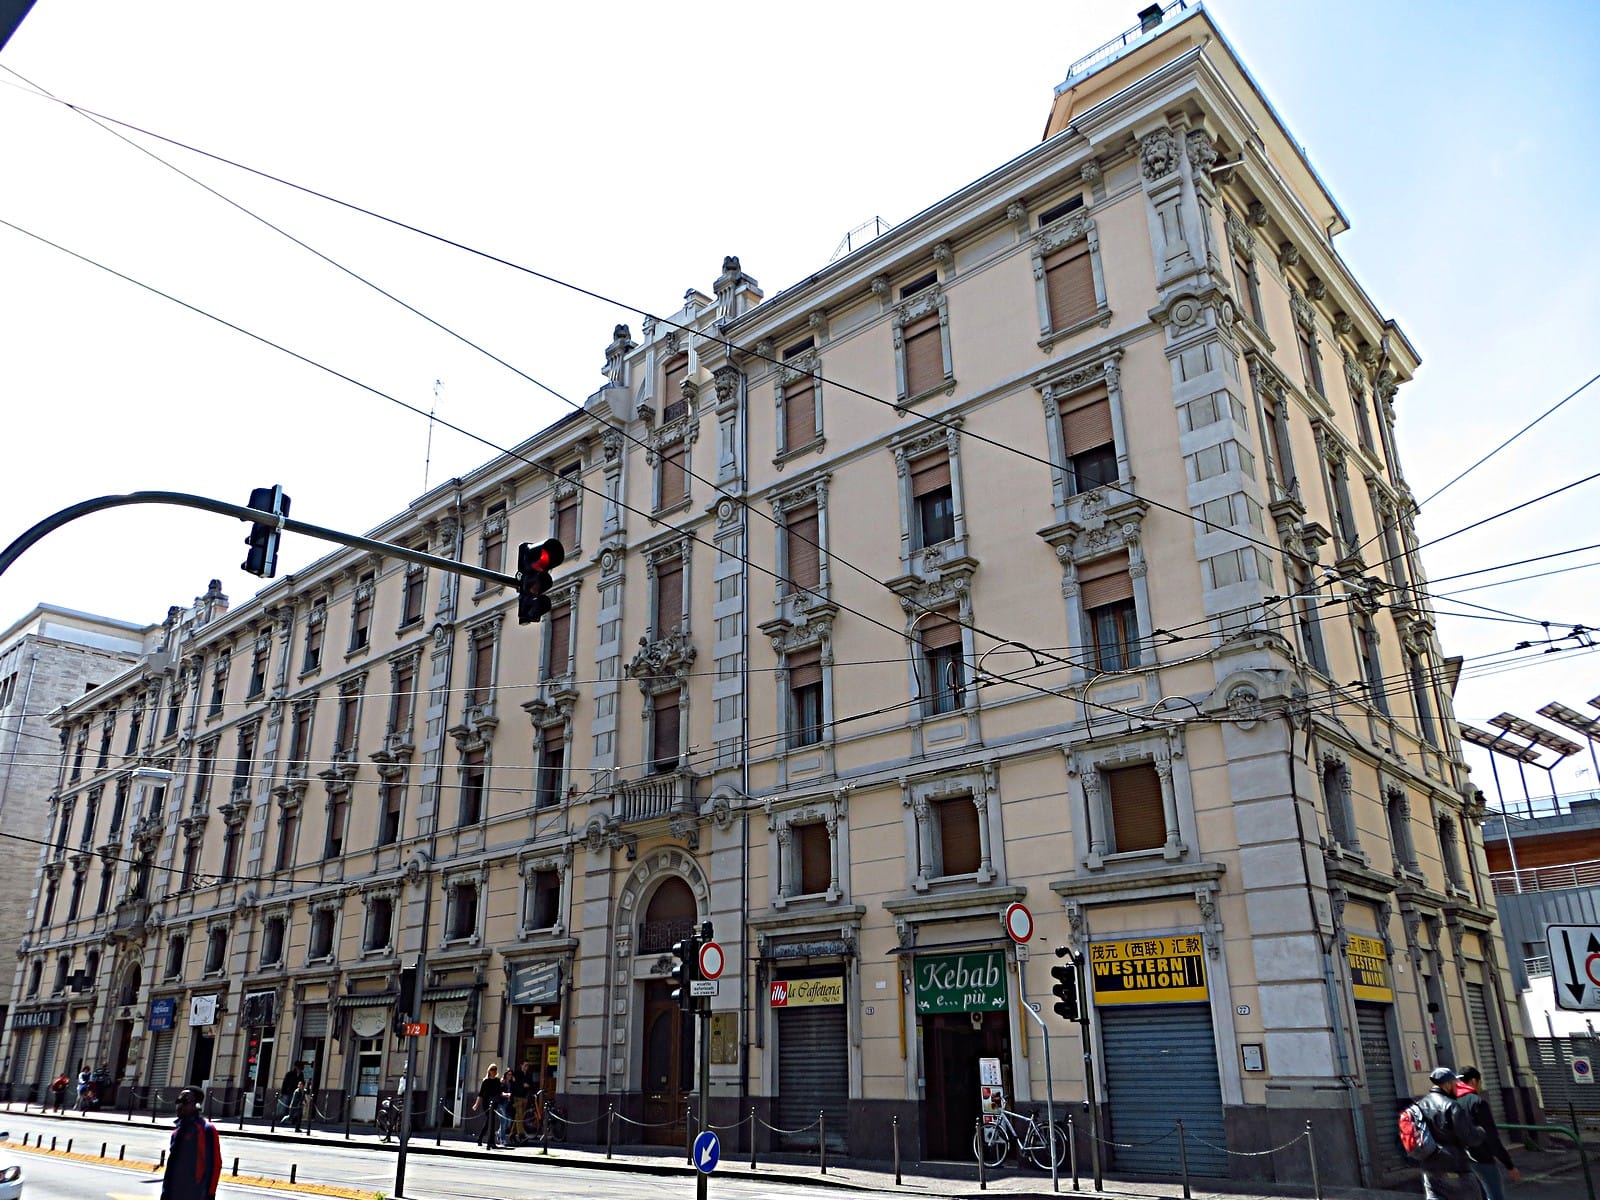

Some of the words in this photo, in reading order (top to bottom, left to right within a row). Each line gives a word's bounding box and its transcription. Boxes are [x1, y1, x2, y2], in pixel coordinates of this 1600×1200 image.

[919, 954, 1000, 991] Kebab
[1094, 957, 1184, 976] WESTERN
[1123, 972, 1185, 989] UNION
[1361, 971, 1384, 986] UNION
[771, 986, 787, 1004] illy
[798, 982, 841, 1002] Caffetteria
[963, 988, 987, 1010] più
[14, 1012, 50, 1026] FARMACIA
